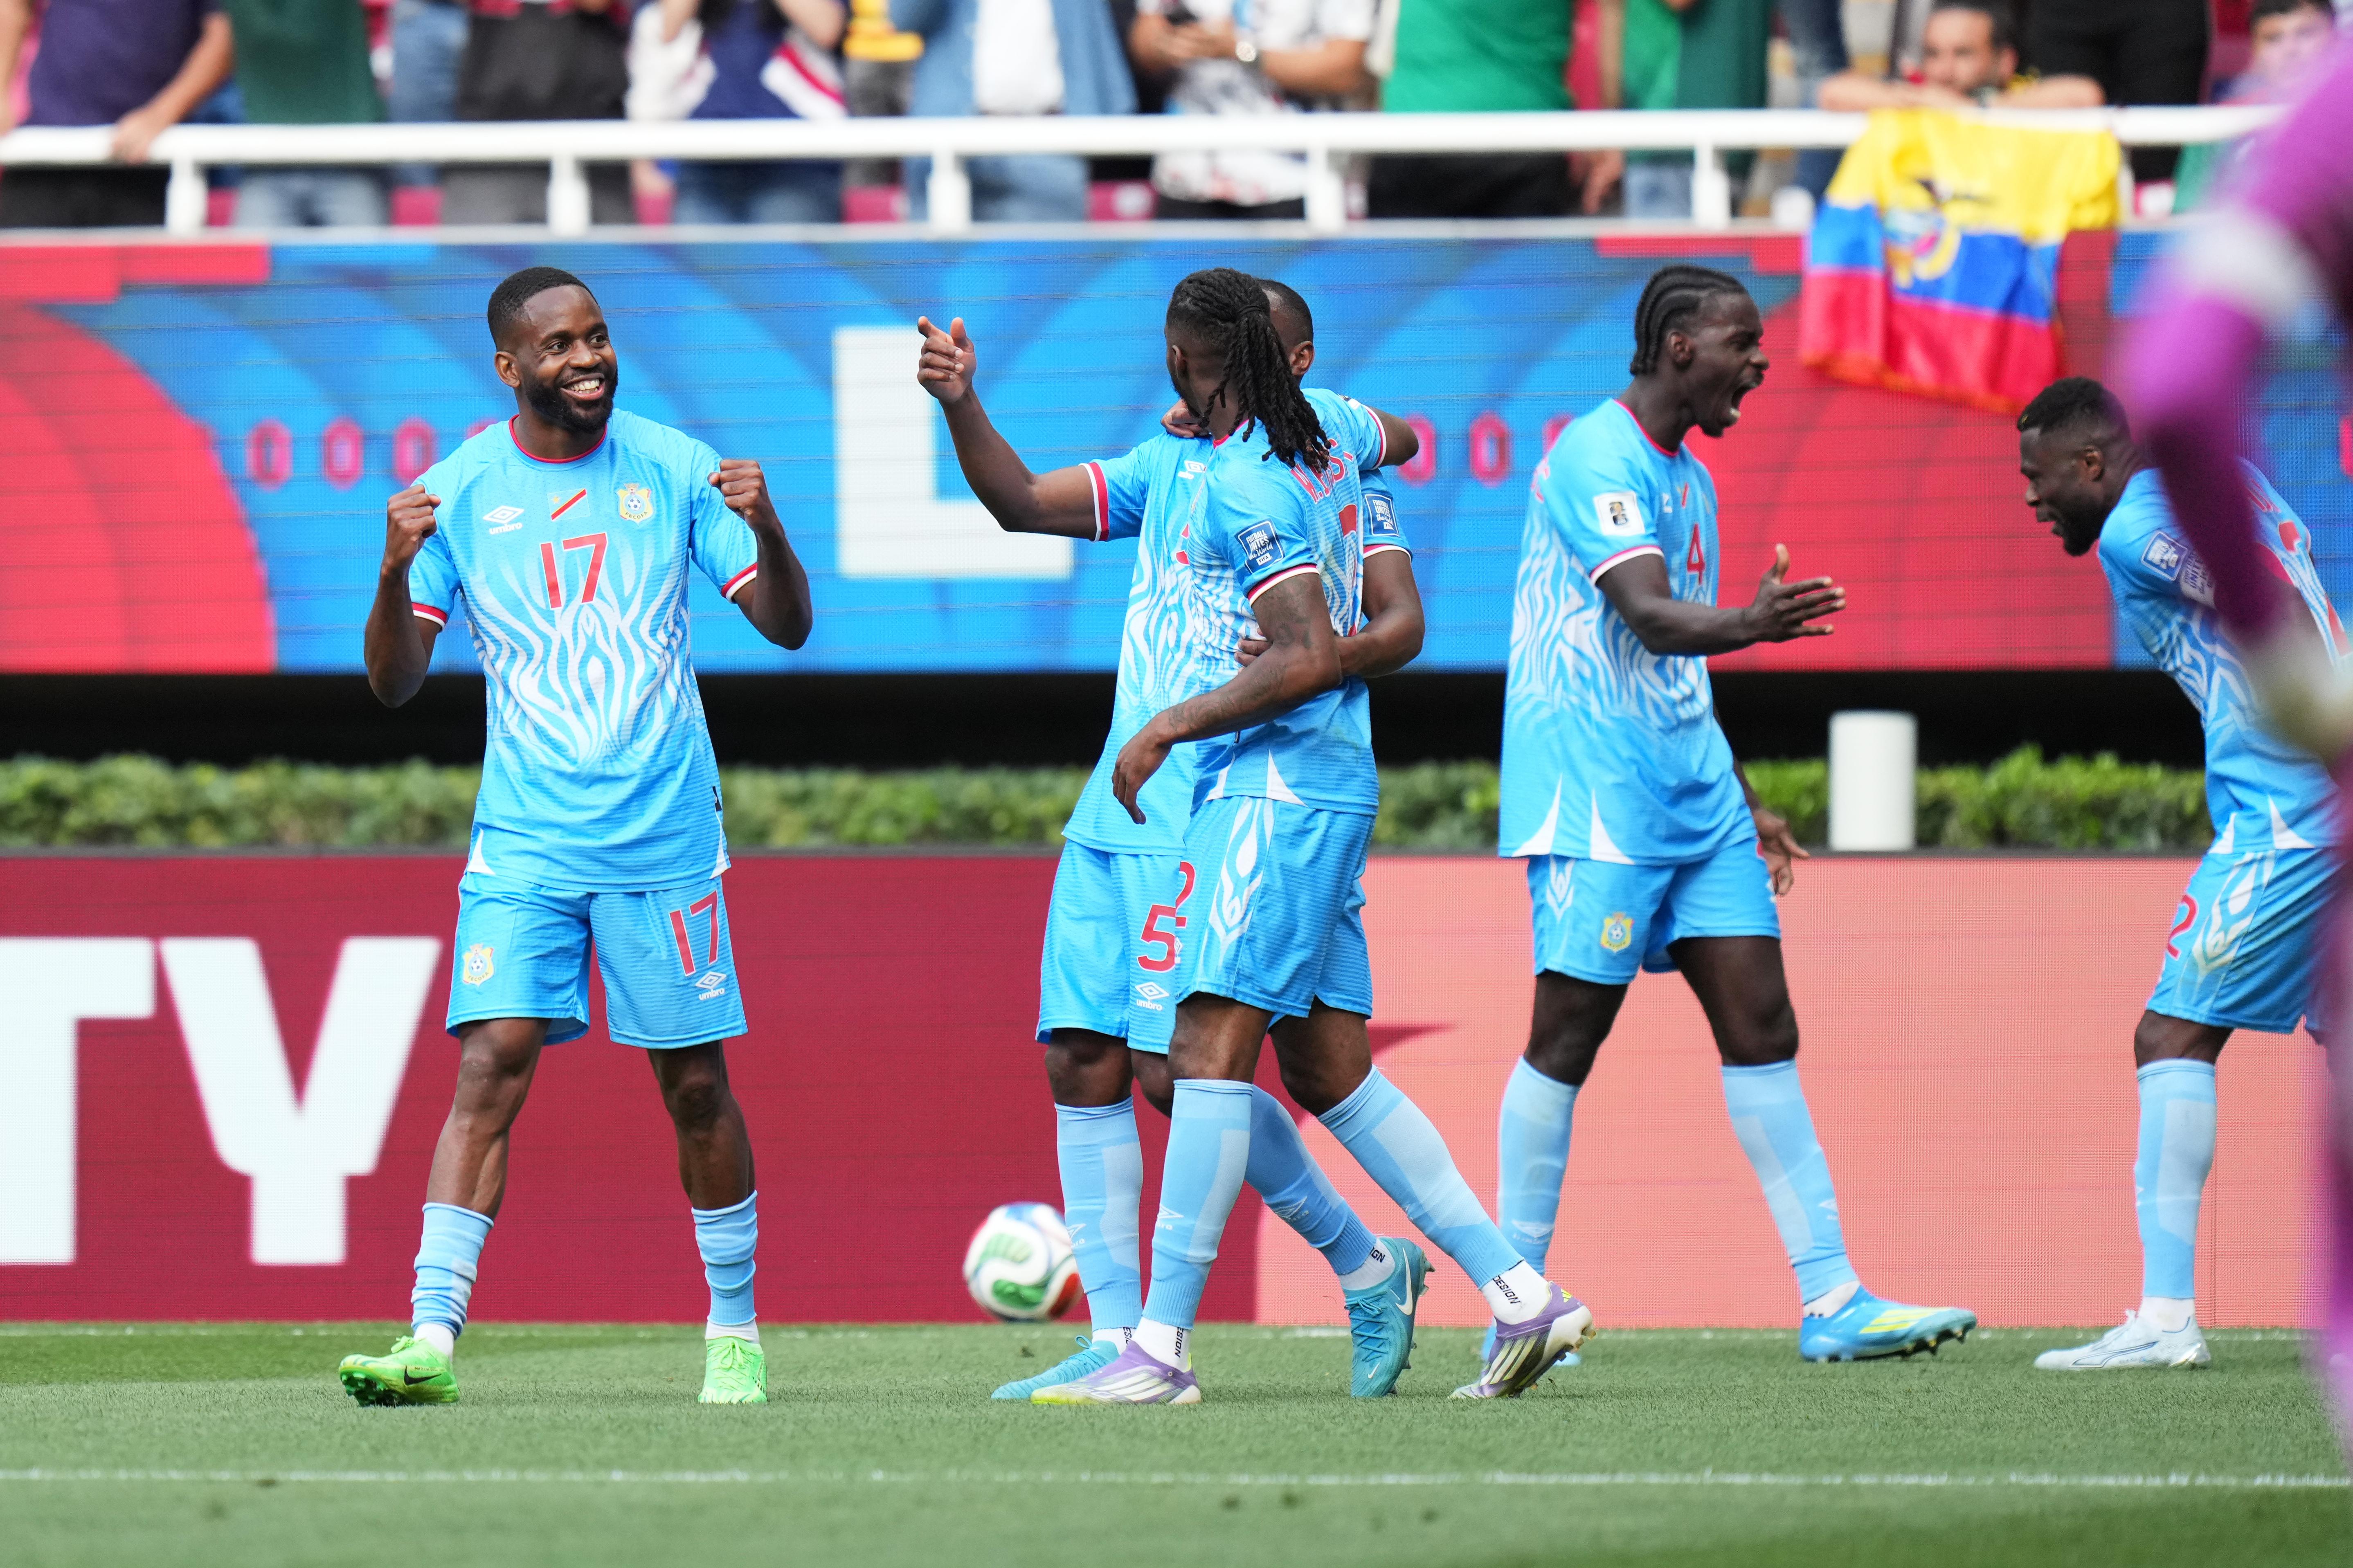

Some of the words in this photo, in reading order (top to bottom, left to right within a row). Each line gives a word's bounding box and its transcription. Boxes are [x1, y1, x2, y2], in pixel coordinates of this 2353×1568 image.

[833, 325, 1074, 580] L
[489, 522, 522, 535] umbro
[540, 532, 608, 609] 17
[1687, 523, 1706, 586] 4
[668, 890, 719, 977] 17
[1137, 903, 1176, 973] 5
[468, 972, 489, 982] FECOFA
[699, 988, 725, 1001] umbro
[1136, 999, 1163, 1012] umbro
[1492, 1275, 1521, 1304] DESIGN
